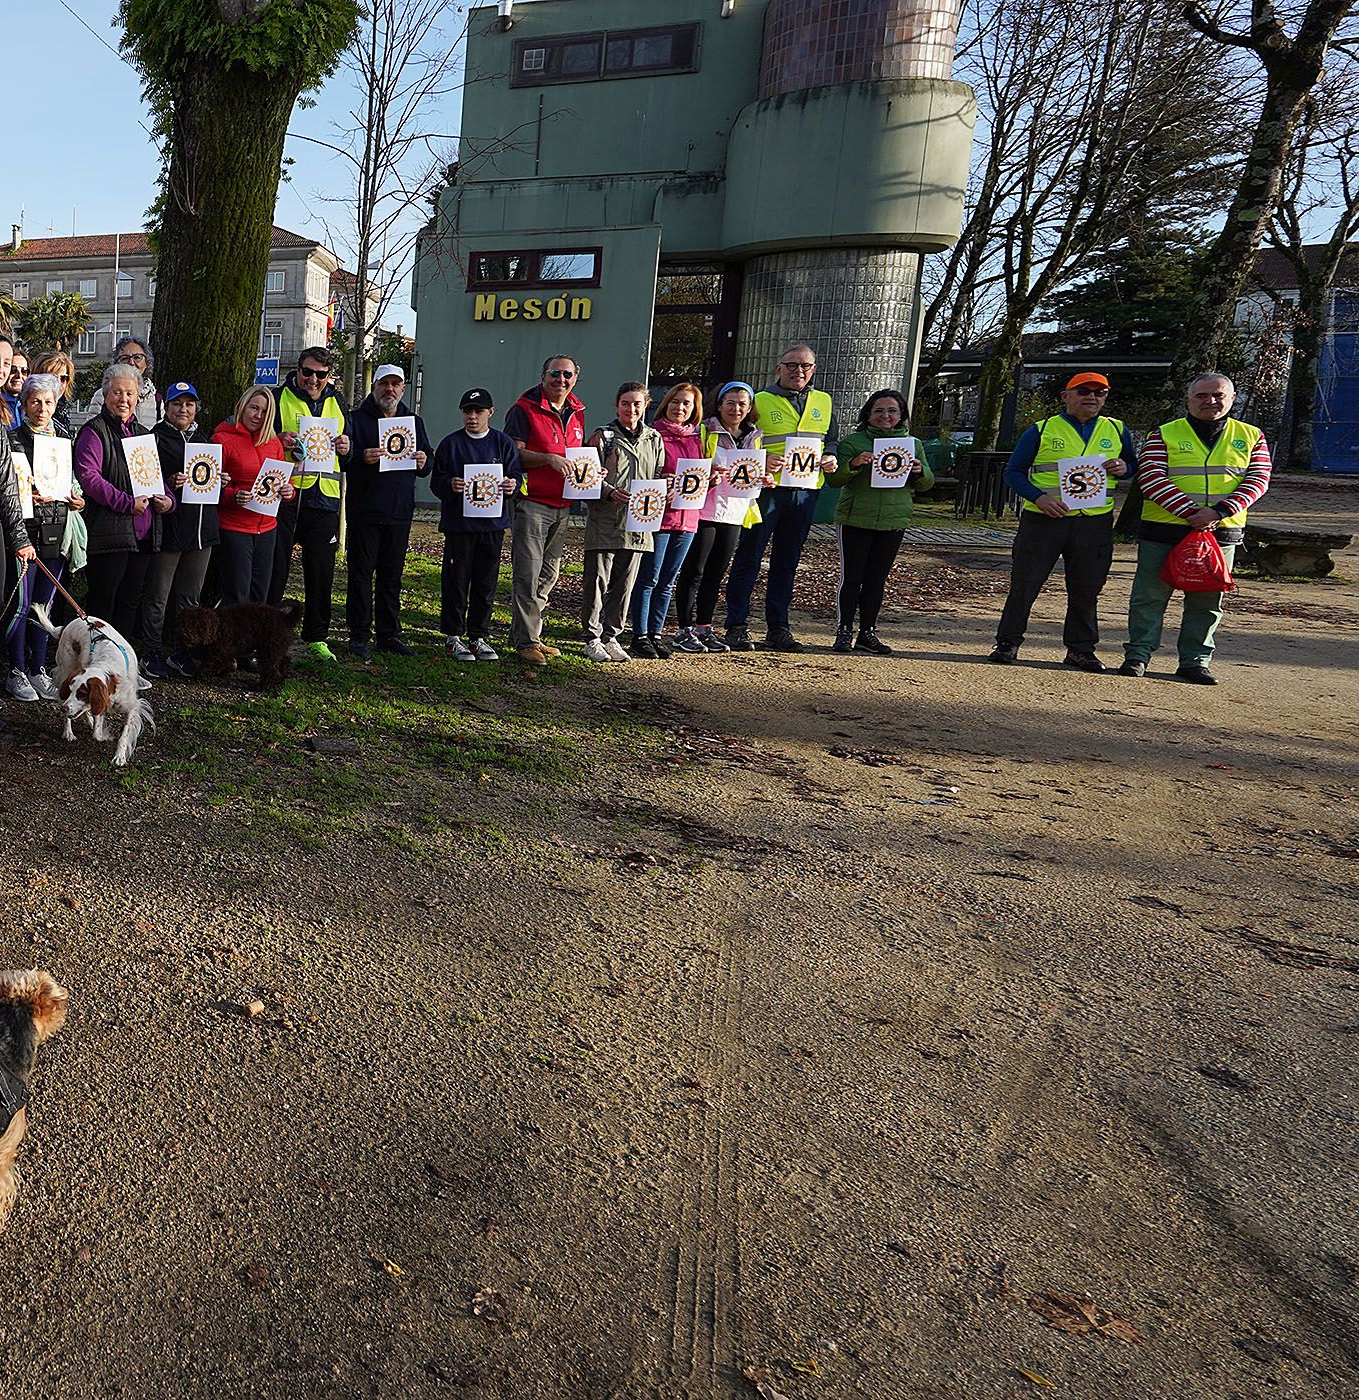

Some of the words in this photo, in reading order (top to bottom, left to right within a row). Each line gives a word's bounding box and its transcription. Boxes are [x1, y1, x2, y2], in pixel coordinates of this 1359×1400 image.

[474, 292, 592, 321] Mesón
[256, 367, 278, 377] TAXI
[387, 433, 406, 455] O
[791, 452, 815, 472] M
[880, 453, 902, 473] O
[192, 461, 211, 486] O
[573, 463, 589, 483] V
[731, 464, 751, 485] A
[1068, 472, 1087, 493] S
[257, 475, 276, 497] S
[473, 480, 485, 501] L
[682, 475, 700, 494] D
[643, 495, 650, 516] I
